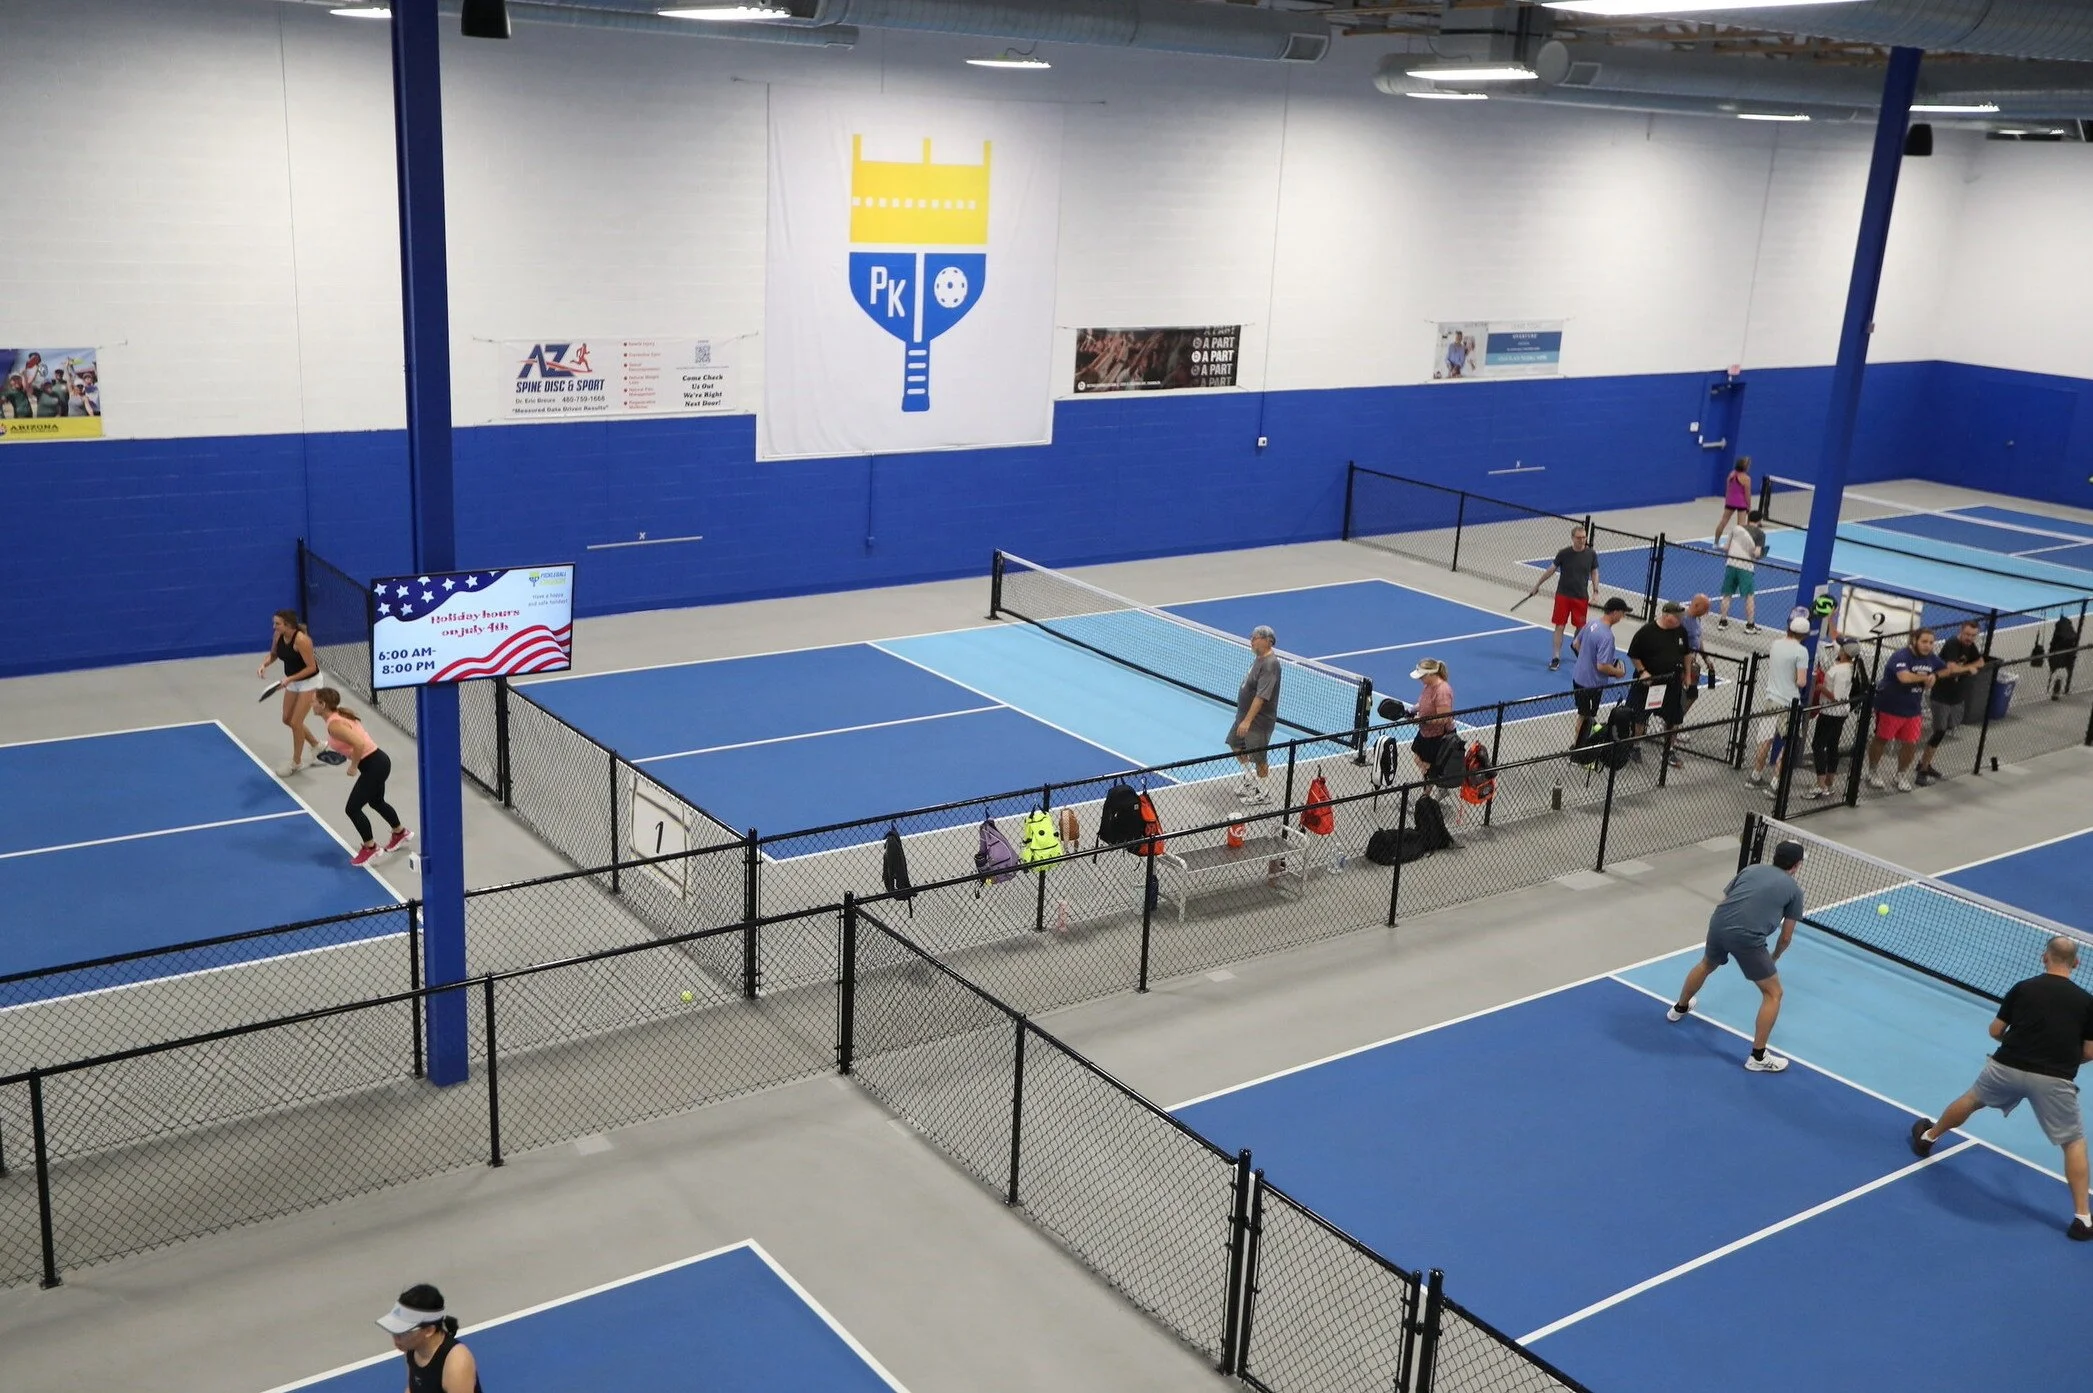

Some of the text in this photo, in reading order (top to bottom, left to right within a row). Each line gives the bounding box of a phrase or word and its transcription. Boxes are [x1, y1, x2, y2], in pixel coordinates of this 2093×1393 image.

[870, 266, 906, 317] PK
[1203, 337, 1235, 349] A PART
[517, 344, 574, 378] AZ
[1202, 350, 1209, 362] A
[1210, 350, 1234, 362] PART
[1201, 364, 1233, 376] A PART
[516, 379, 605, 393] SPINE DISC & SPORT
[10, 423, 59, 431] ARIZONA
[431, 610, 520, 624] Holiday hours
[1869, 612, 1886, 634] 2
[487, 622, 509, 632] 4th
[378, 649, 408, 661] 6:00
[382, 661, 435, 674] 8:00 PM
[655, 821, 664, 854] 1
